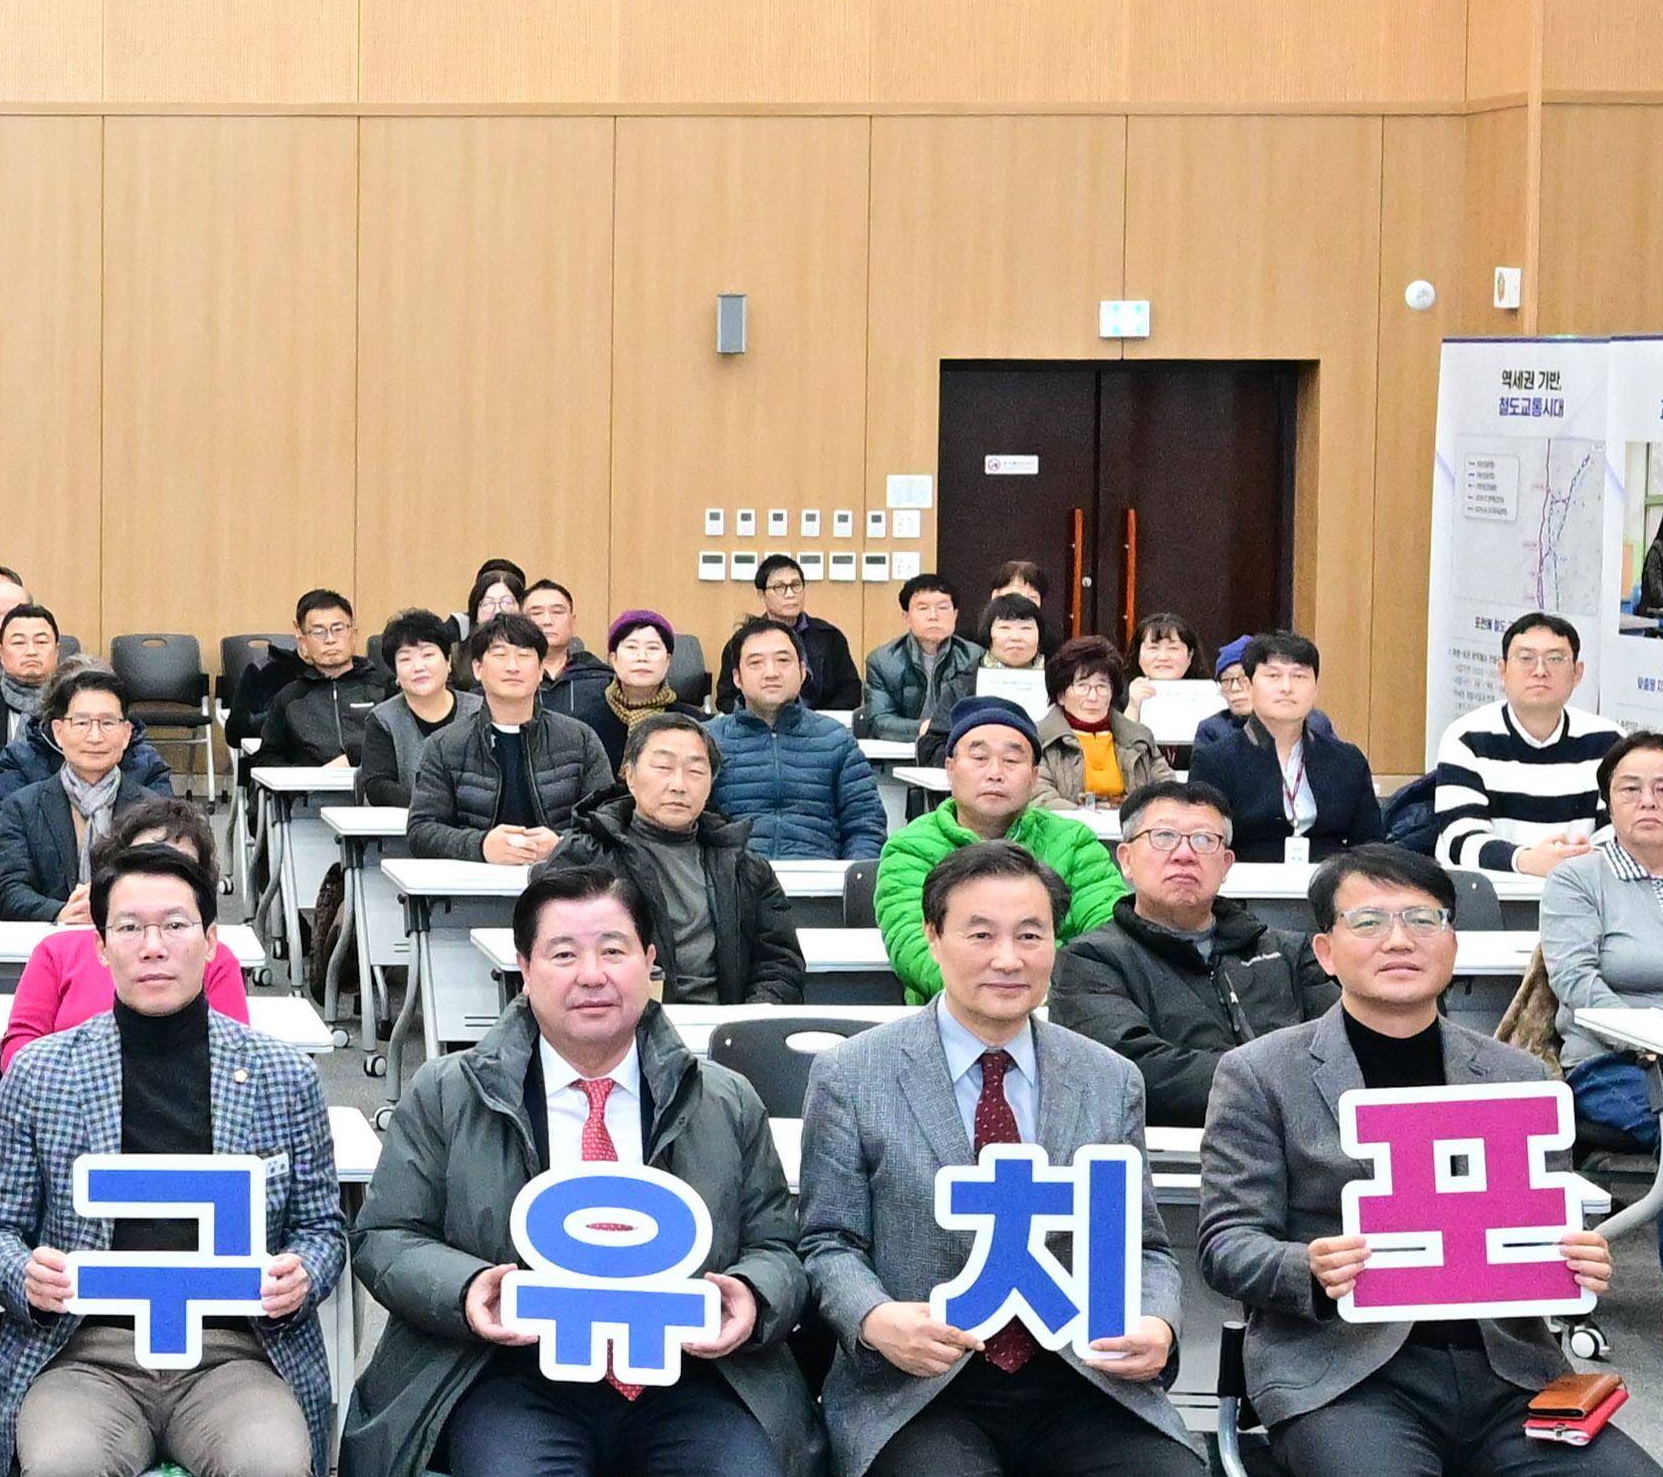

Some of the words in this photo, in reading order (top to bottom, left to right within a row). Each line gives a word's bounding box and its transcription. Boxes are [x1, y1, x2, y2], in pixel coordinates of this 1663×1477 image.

[1501, 370, 1534, 391] 역세권
[1538, 370, 1563, 391] 기반,
[1498, 396, 1564, 419] 철도교통시대
[77, 1168, 263, 1354] 구
[515, 1174, 706, 1370] 유
[946, 1157, 1128, 1339] 치
[1353, 1095, 1583, 1309] 포
